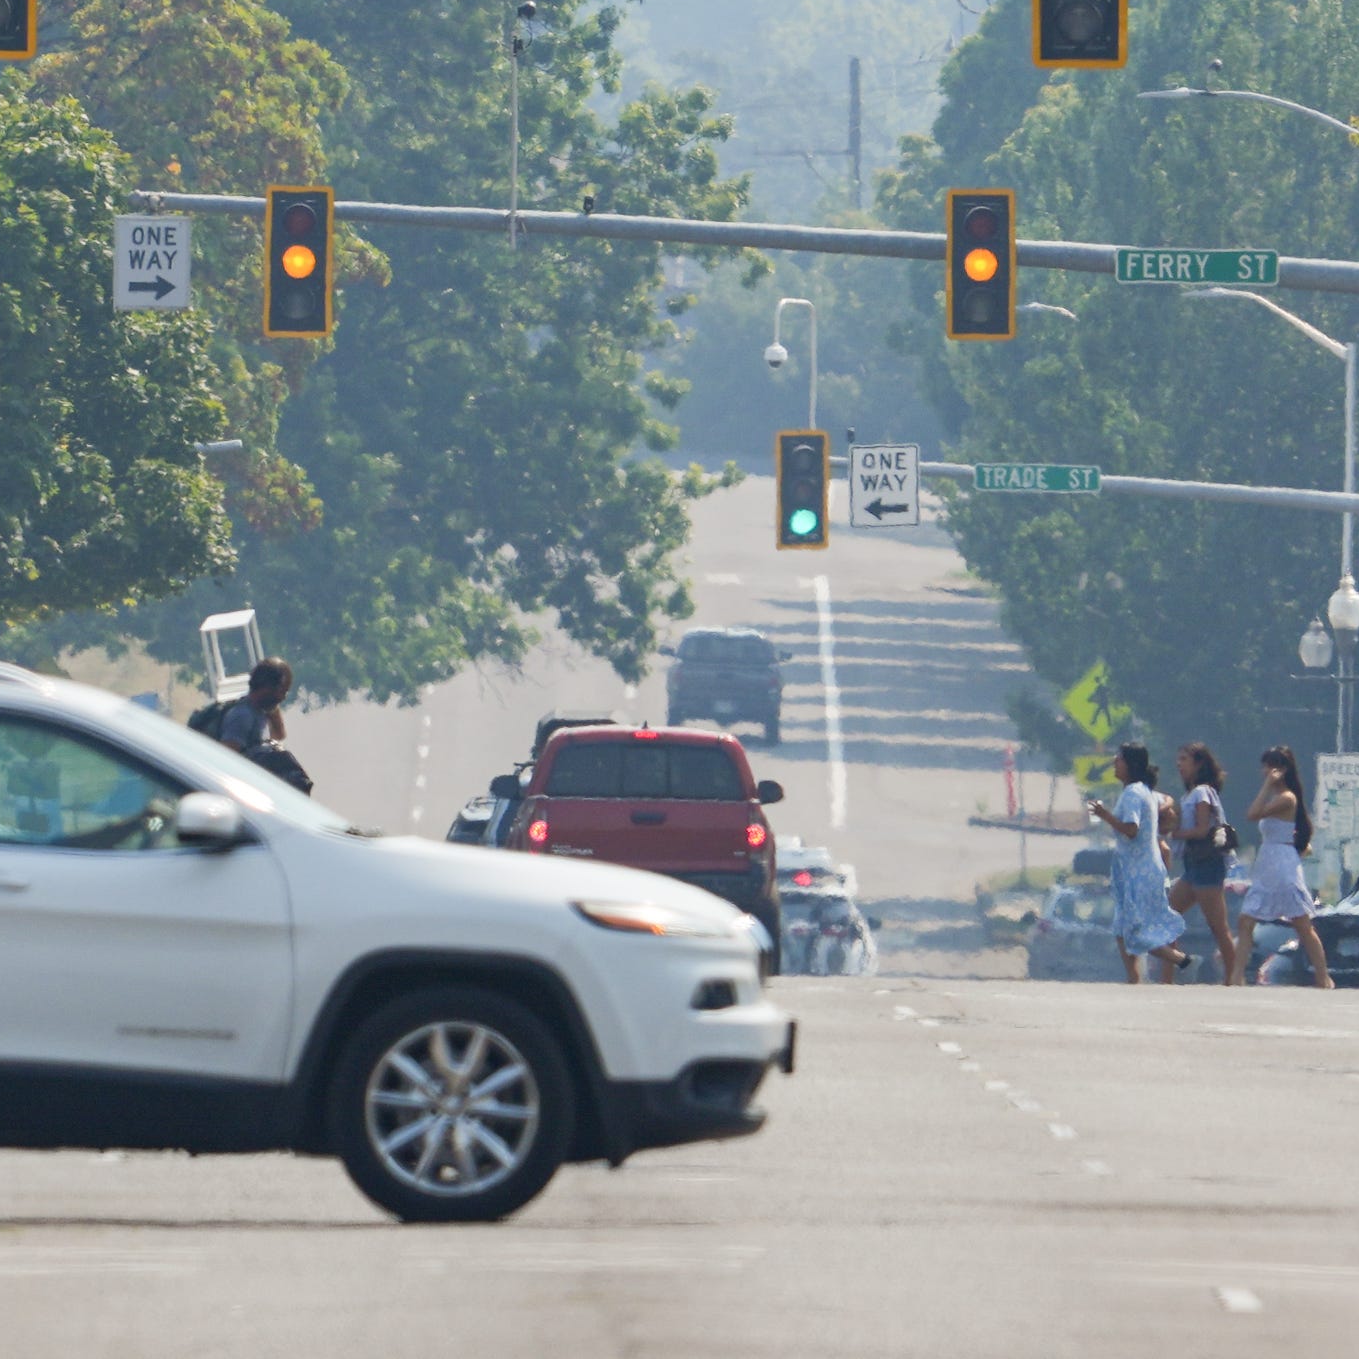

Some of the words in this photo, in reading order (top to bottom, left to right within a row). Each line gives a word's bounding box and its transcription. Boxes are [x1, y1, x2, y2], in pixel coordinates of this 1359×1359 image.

[132, 226, 176, 246] ONE
[128, 250, 178, 270] WAY
[1126, 253, 1210, 279] FERRY
[1237, 254, 1269, 280] ST
[861, 452, 907, 470] ONE
[860, 474, 907, 491] WAY
[982, 466, 1048, 489] TRADE
[1068, 469, 1093, 490] ST
